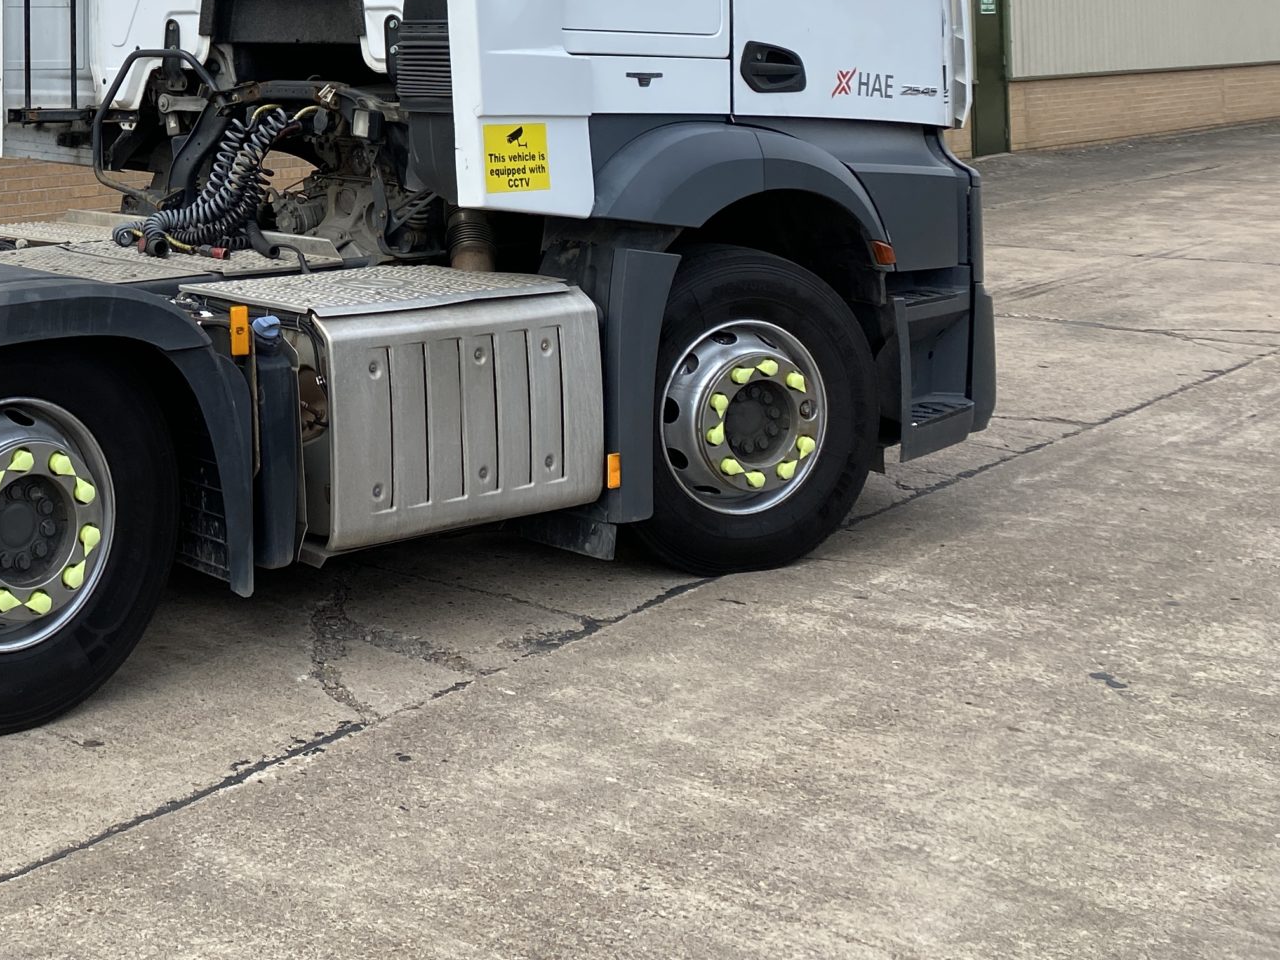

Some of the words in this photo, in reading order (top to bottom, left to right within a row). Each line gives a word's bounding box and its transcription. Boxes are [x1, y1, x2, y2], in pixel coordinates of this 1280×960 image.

[488, 153, 506, 163] This
[508, 152, 536, 162] vehicle
[538, 151, 546, 161] is
[489, 165, 526, 178] equipped
[529, 164, 546, 174] with
[508, 177, 530, 188] CCTV
